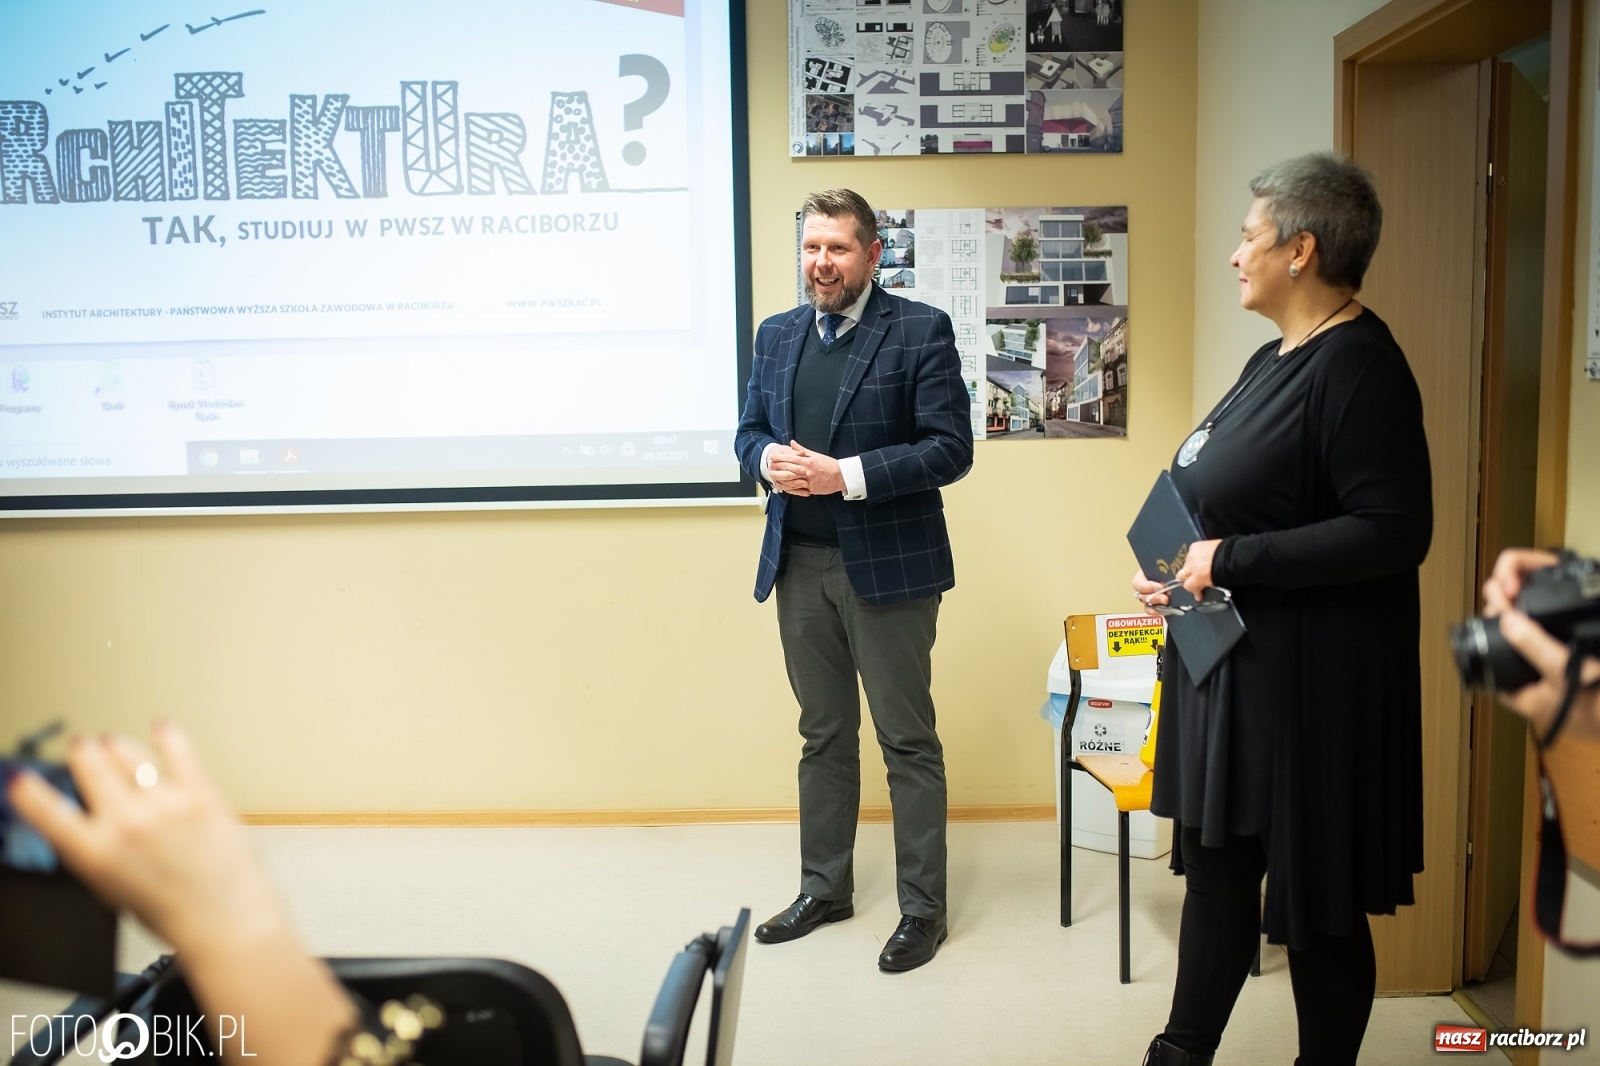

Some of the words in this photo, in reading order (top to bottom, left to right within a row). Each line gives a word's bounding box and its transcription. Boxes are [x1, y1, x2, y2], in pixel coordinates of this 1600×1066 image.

[142, 215, 226, 248] TAK,
[238, 219, 333, 240] STUDIUJ
[345, 219, 368, 238] W
[379, 216, 445, 237] PWSZ
[450, 215, 475, 235] W
[481, 212, 620, 234] RACIBORZU
[42, 310, 87, 319] INSTYTUT
[89, 307, 162, 318] ARCHITEKTURY
[170, 304, 235, 316] PAŃSTWOWA
[237, 303, 278, 315] WYŻSZA
[279, 304, 318, 314] SZKOŁA
[320, 302, 383, 313] ZAWODOWA
[385, 301, 395, 311] W
[397, 301, 454, 312] RACIBORZU
[6, 456, 76, 469] wyszukiwane
[80, 456, 111, 466] słowa
[1108, 618, 1162, 628] OBOWIĄZEK!
[1108, 628, 1163, 638] DEZYNFEKCJI
[1124, 637, 1148, 645] RĄK!!!
[1080, 739, 1122, 752] RÓŻNE
